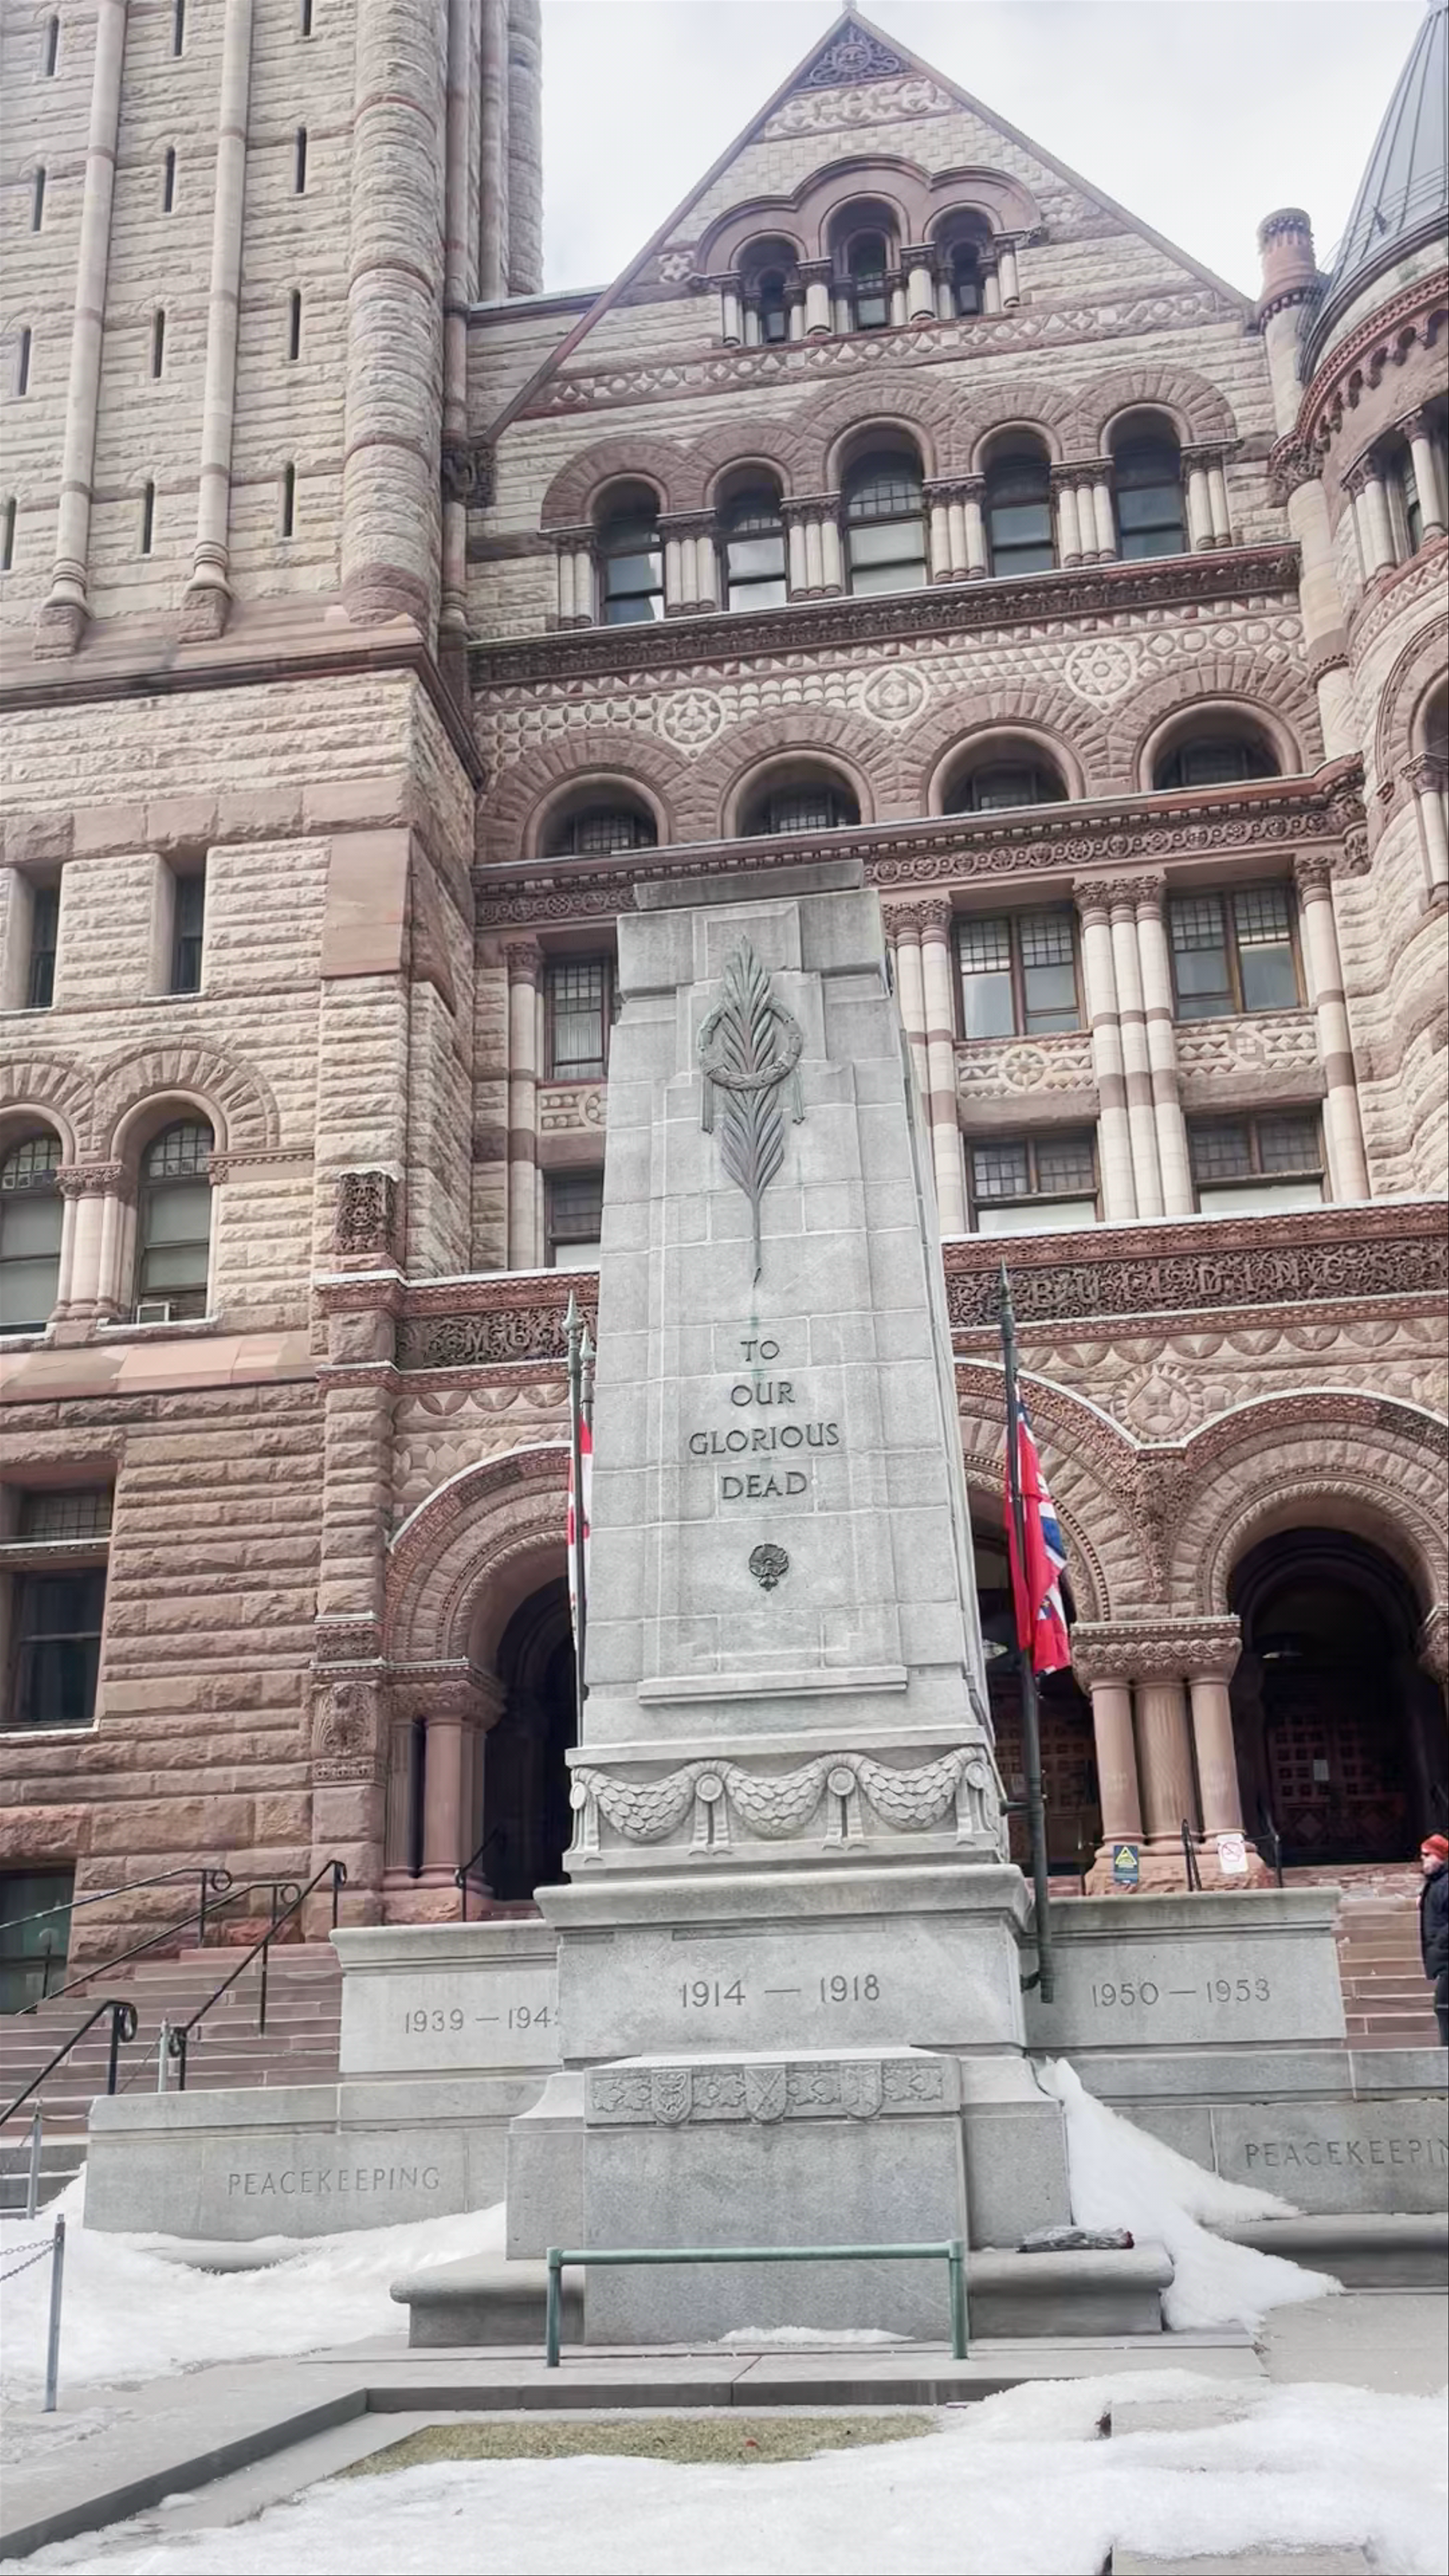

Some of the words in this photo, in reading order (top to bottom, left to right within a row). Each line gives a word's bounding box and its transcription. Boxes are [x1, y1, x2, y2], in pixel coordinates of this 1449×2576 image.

[740, 1339, 780, 1362] TO
[730, 1381, 795, 1407] OUR
[689, 1422, 840, 1455] GLORIOUS
[720, 1471, 808, 1500] DEAD
[681, 1978, 747, 2008] 1914
[820, 1974, 880, 2003] 1918
[1092, 1981, 1159, 2007] 1950
[1206, 1978, 1272, 2004] 1953
[405, 2009, 464, 2034] 1939
[228, 2167, 440, 2196] PEACEKEEPING
